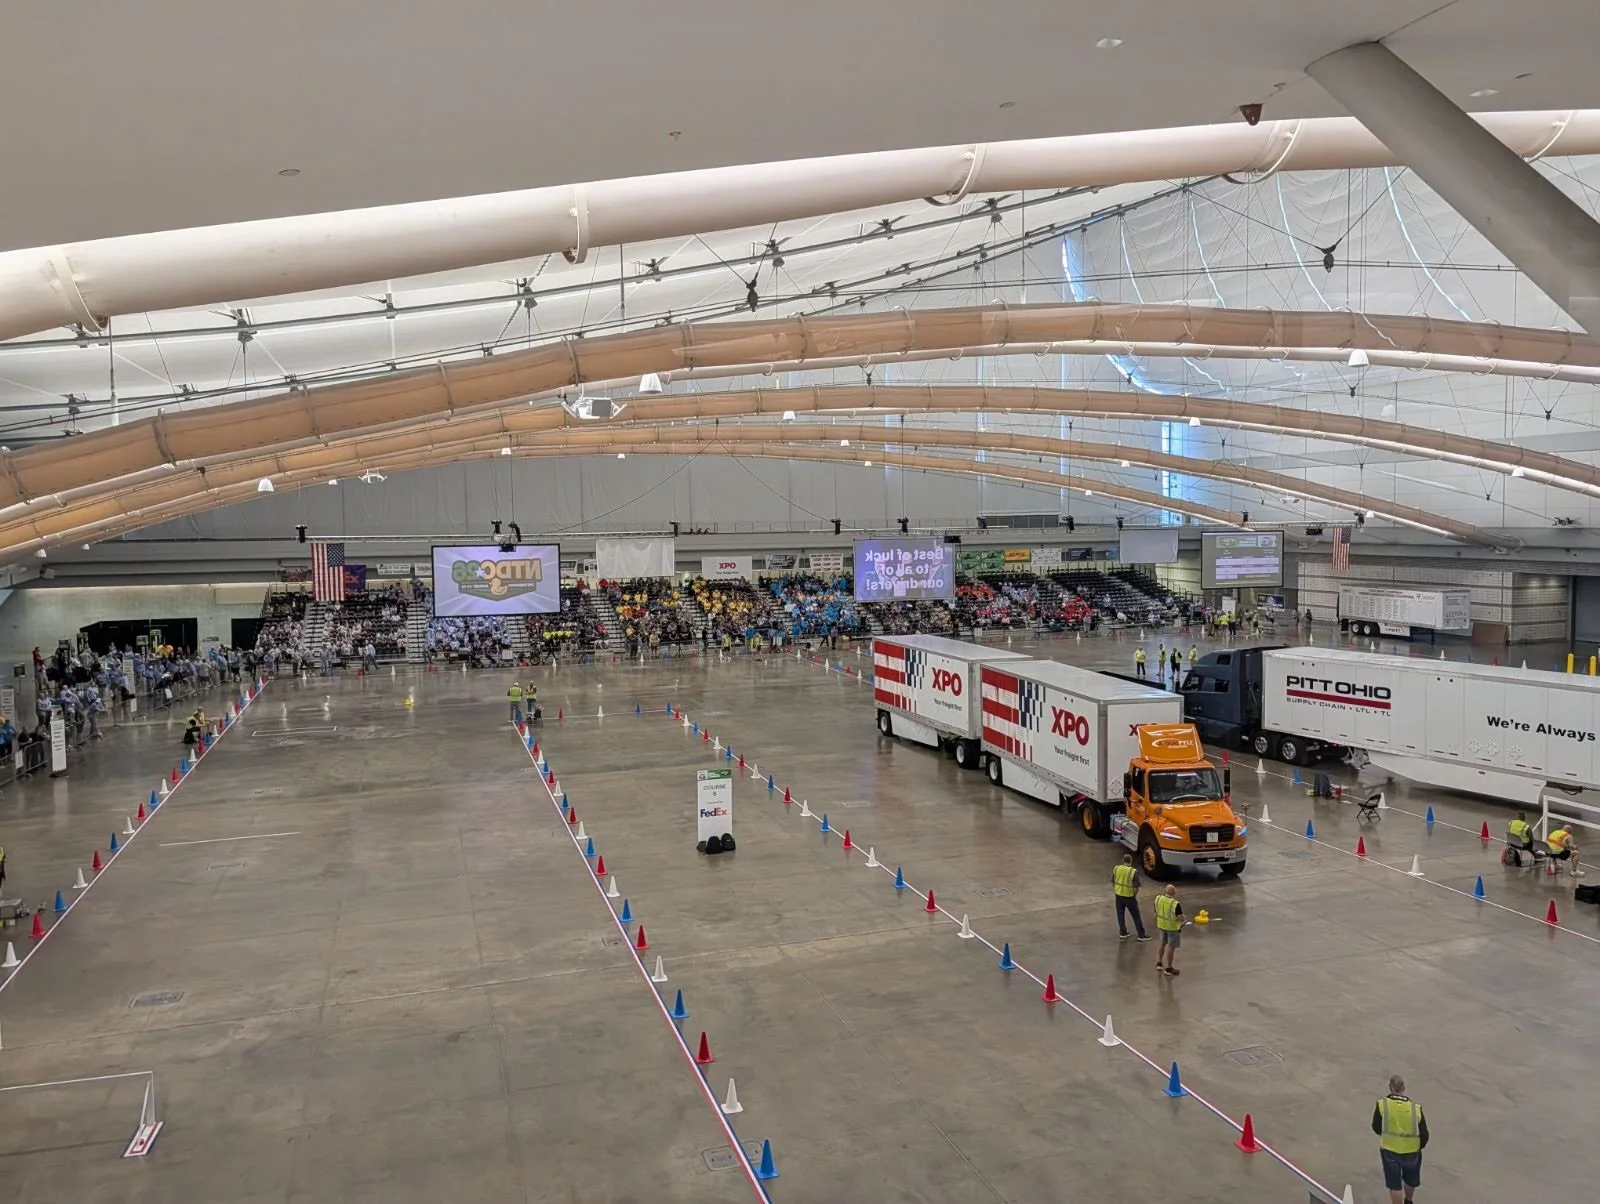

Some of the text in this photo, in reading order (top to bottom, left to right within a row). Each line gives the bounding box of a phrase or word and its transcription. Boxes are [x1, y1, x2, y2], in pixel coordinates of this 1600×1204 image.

[718, 562, 737, 570] XPO
[931, 666, 962, 697] XPO
[1286, 697, 1317, 707] SUPPLY
[1319, 701, 1346, 711] CHAIN
[1051, 704, 1089, 746] XPO
[1536, 722, 1596, 743] Always
[1054, 744, 1064, 756] Your
[1064, 748, 1080, 762] freight
[700, 807, 727, 818] FedEx
